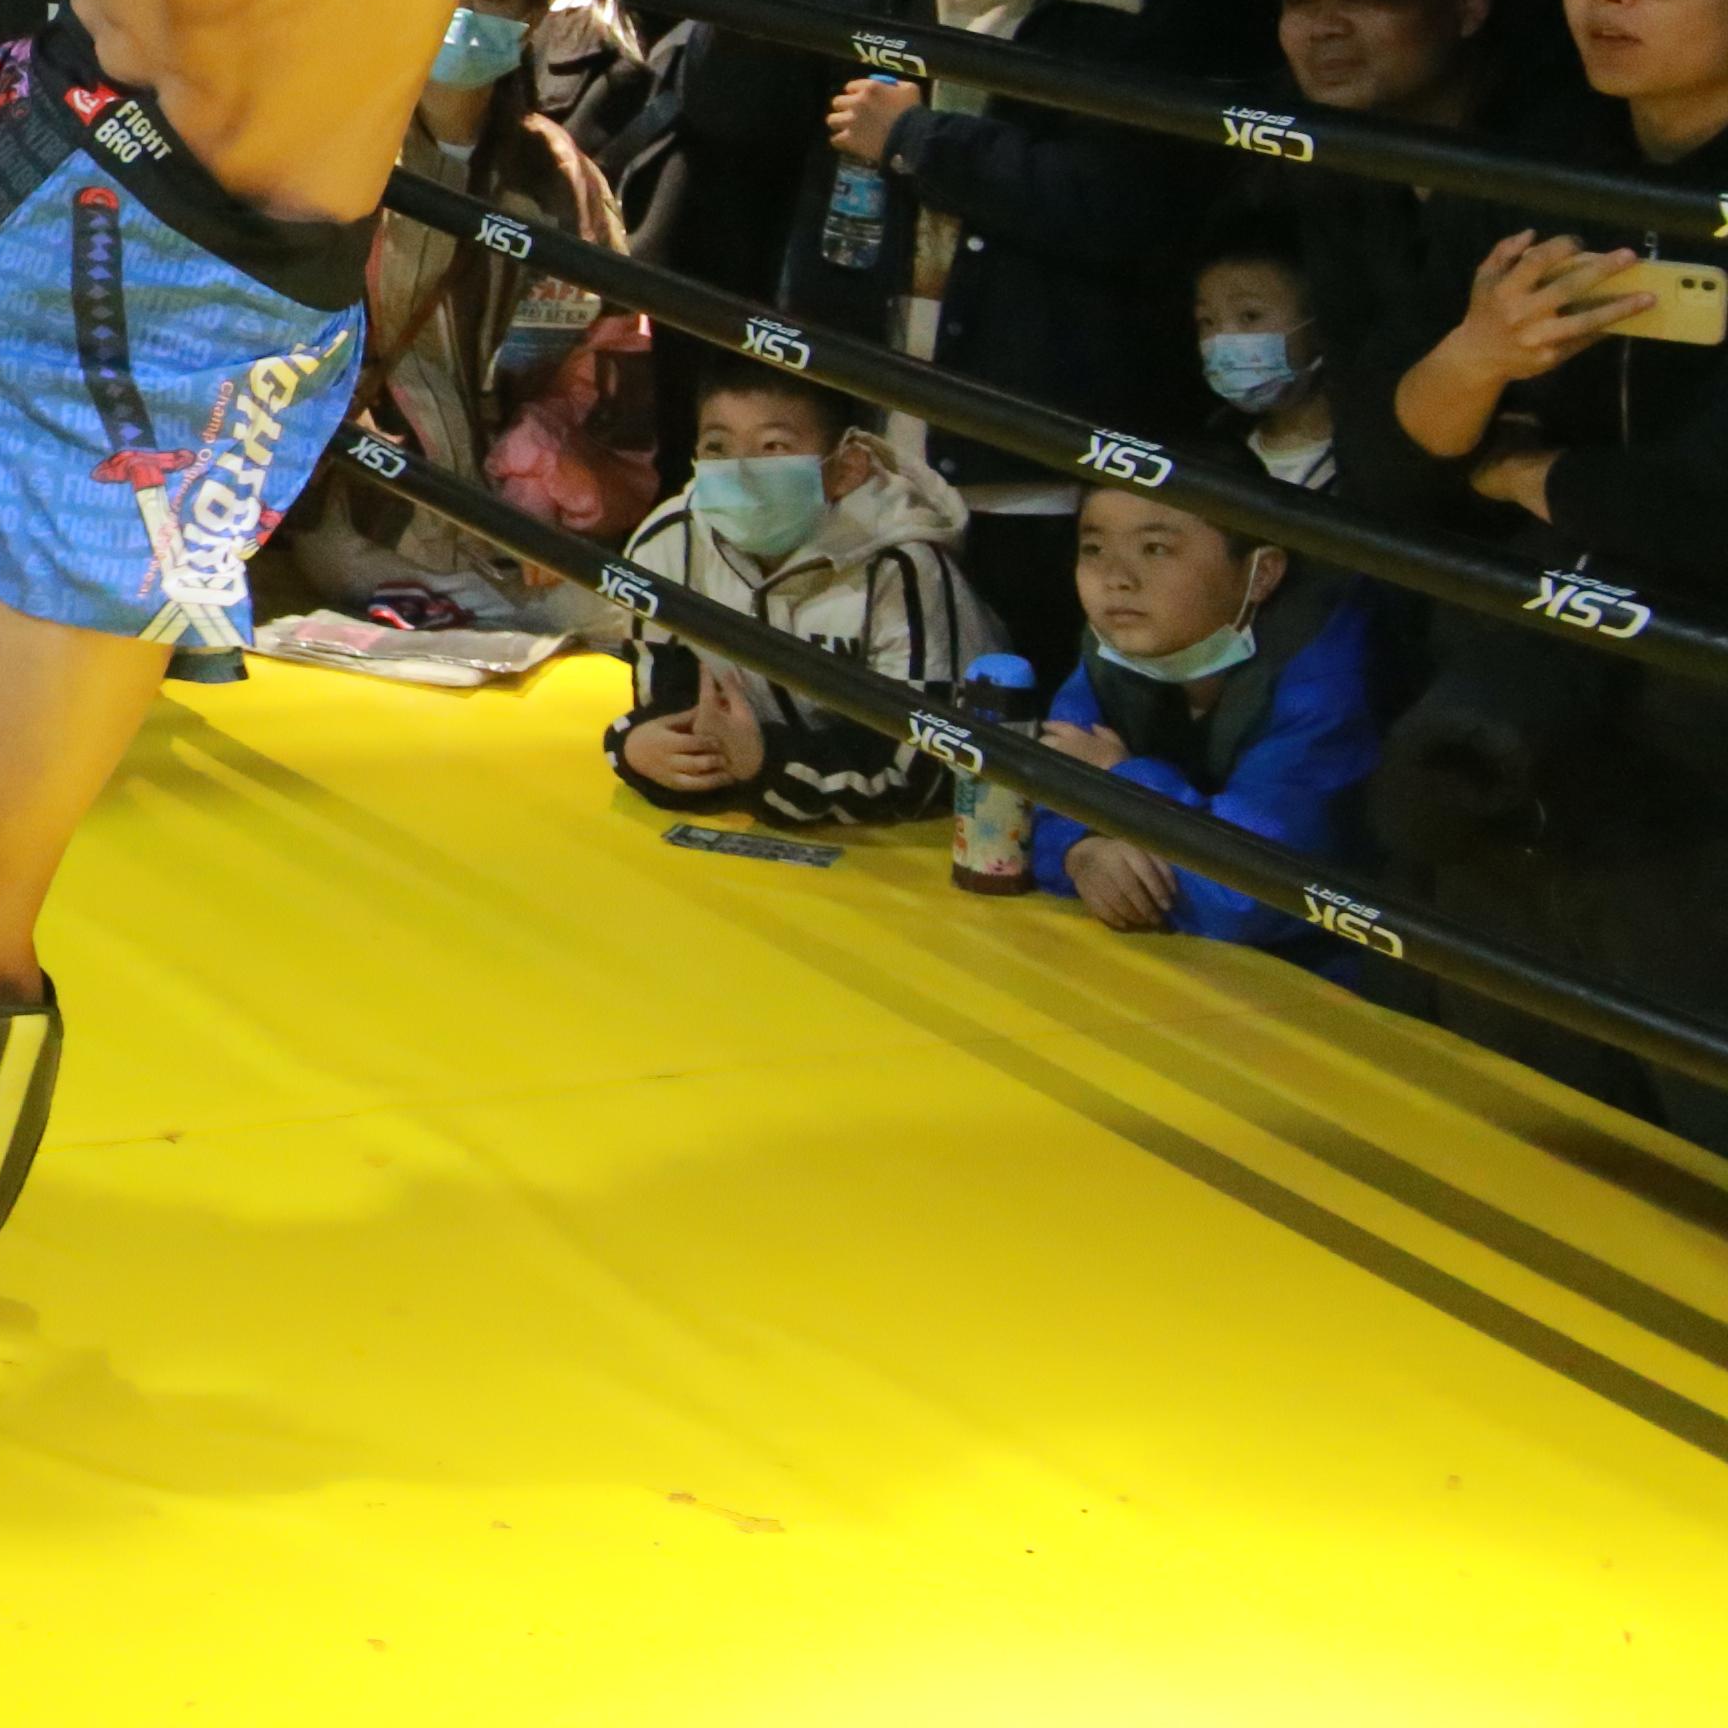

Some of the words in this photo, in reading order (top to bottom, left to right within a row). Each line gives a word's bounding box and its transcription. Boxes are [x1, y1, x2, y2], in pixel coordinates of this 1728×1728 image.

[853, 41, 928, 78] CSK
[94, 118, 143, 163] BRO
[115, 100, 173, 160] FIGHT
[1223, 116, 1314, 162] CSK
[475, 218, 532, 259] CSK
[741, 323, 811, 370] CSK
[347, 435, 407, 478] CSK
[1076, 434, 1173, 487] CSK
[596, 568, 659, 618] CSK
[1522, 575, 1651, 639] CSK
[906, 717, 984, 772] CSK
[1304, 894, 1404, 960] CSK
